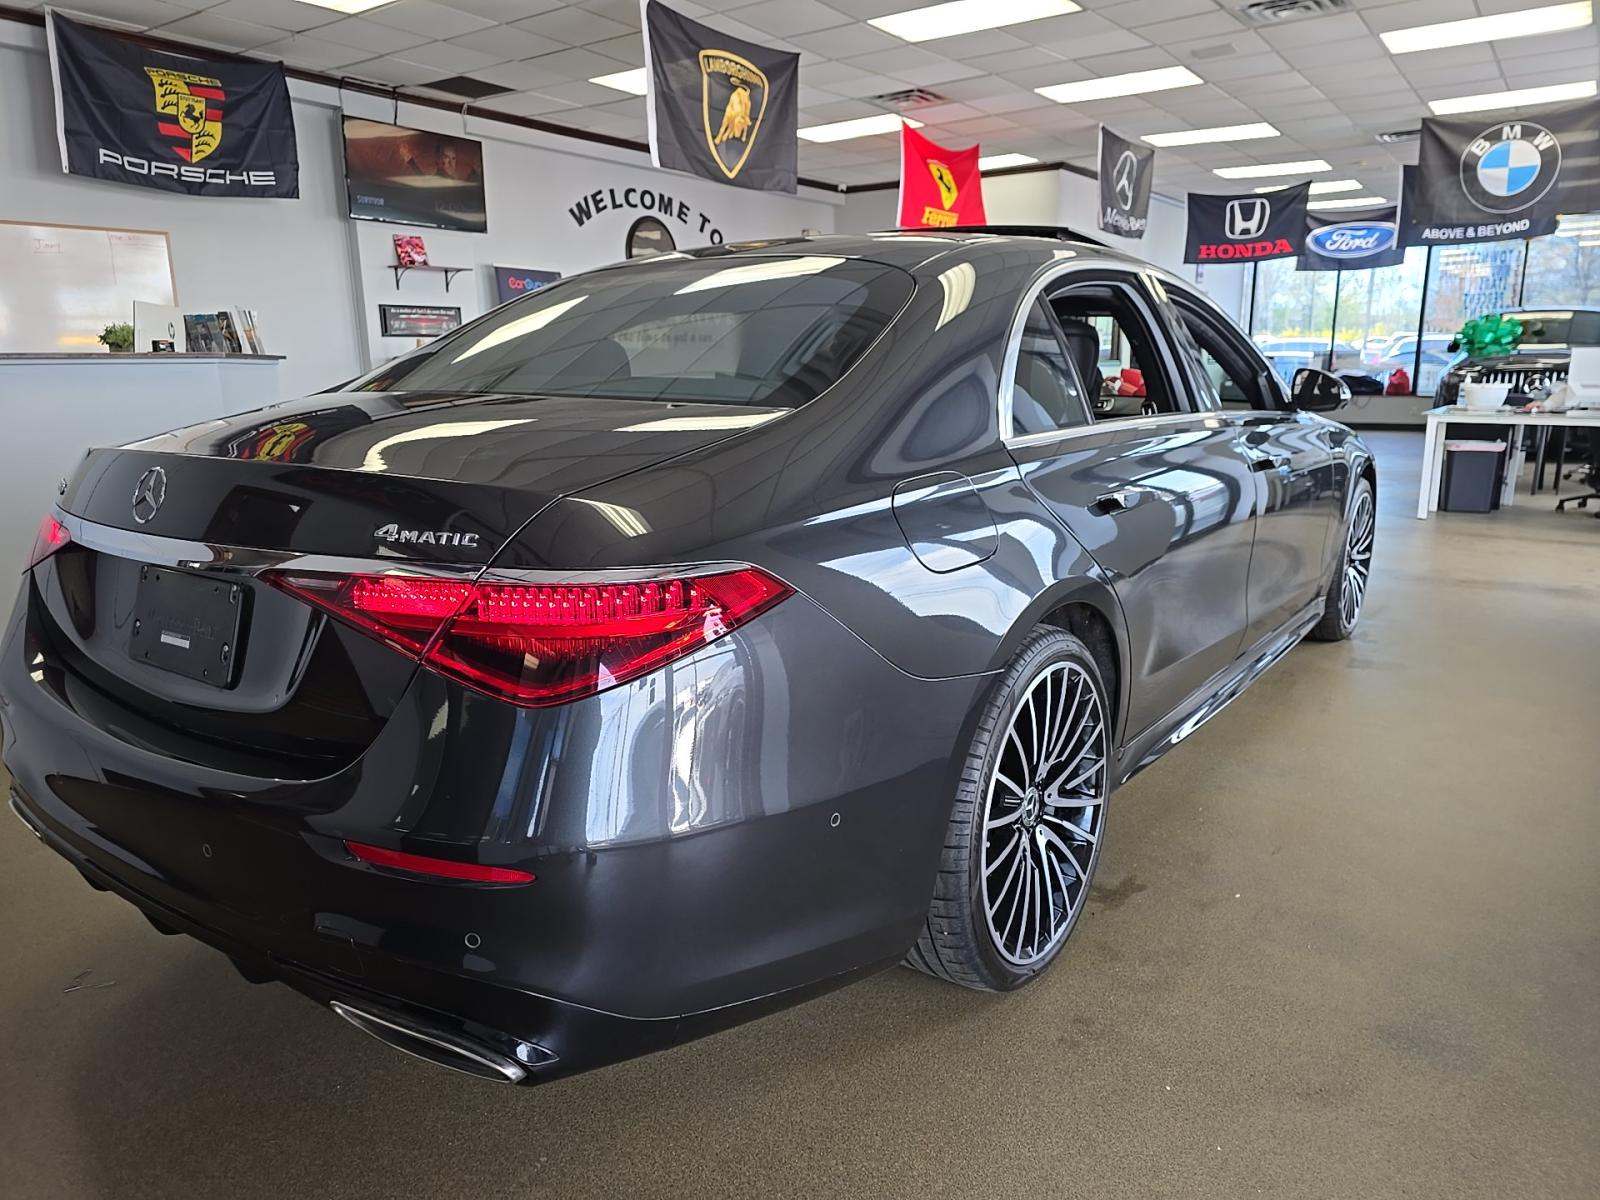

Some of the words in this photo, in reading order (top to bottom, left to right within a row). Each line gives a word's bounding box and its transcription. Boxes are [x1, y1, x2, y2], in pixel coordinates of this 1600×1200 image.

[1471, 124, 1555, 157] BMW
[98, 147, 277, 186] PORSCHE
[568, 187, 691, 228] WELCOME
[698, 212, 723, 246] TO
[1324, 228, 1380, 251] Ford
[1421, 226, 1465, 240] ABOVE
[1466, 226, 1477, 238] &
[1477, 219, 1531, 238] BEYOND
[1197, 238, 1294, 260] HONDA
[373, 523, 480, 548] 4MATIC
